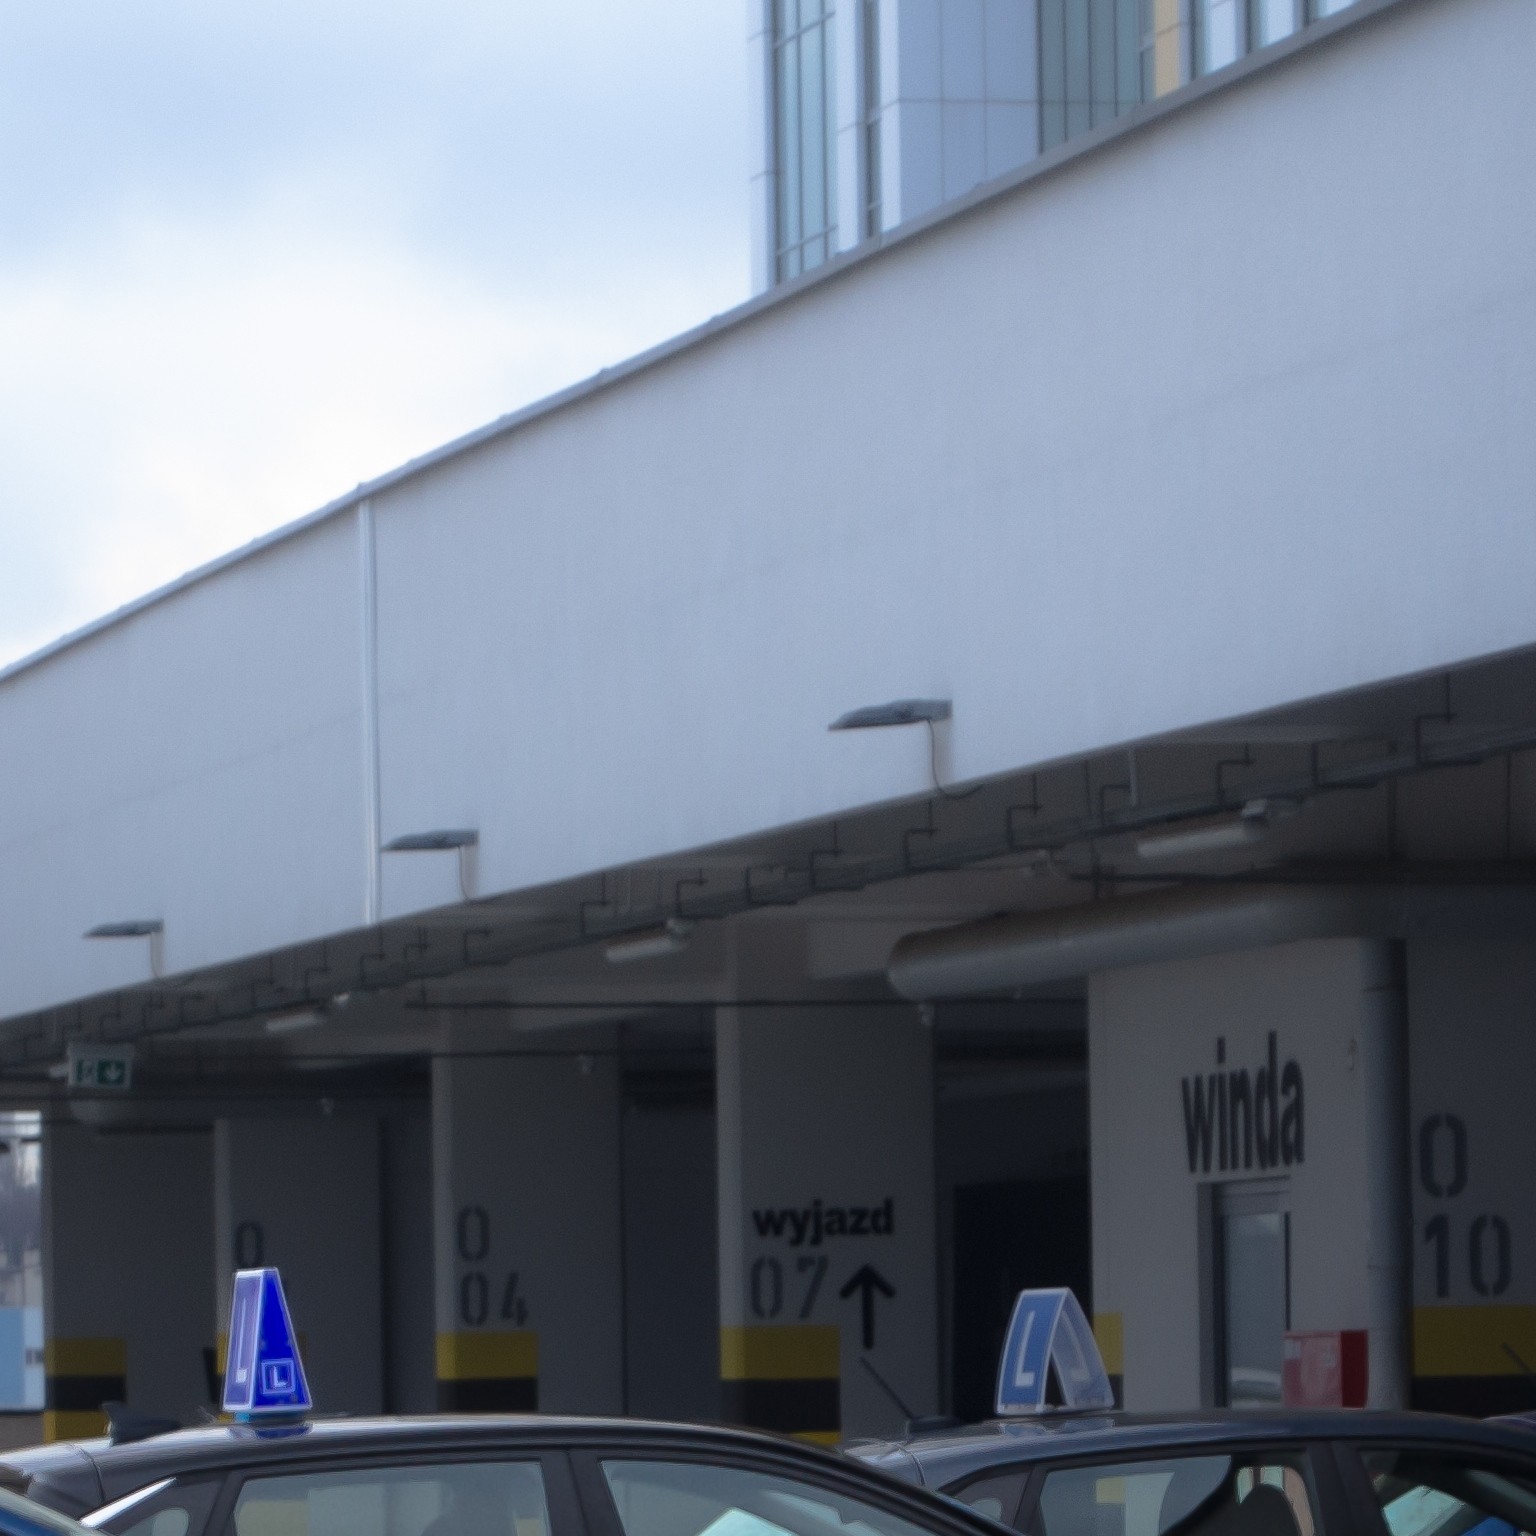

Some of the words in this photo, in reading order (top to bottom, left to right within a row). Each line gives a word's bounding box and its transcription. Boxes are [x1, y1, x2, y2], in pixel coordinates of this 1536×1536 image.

[1181, 1030, 1306, 1174] winda
[1419, 1111, 1467, 1199] 0
[751, 1196, 895, 1246] wyjazd
[1423, 1212, 1512, 1300] 10
[460, 1271, 529, 1327] 04
[750, 1254, 829, 1320] 07
[272, 1365, 288, 1388] L
[1014, 1310, 1036, 1388] L
